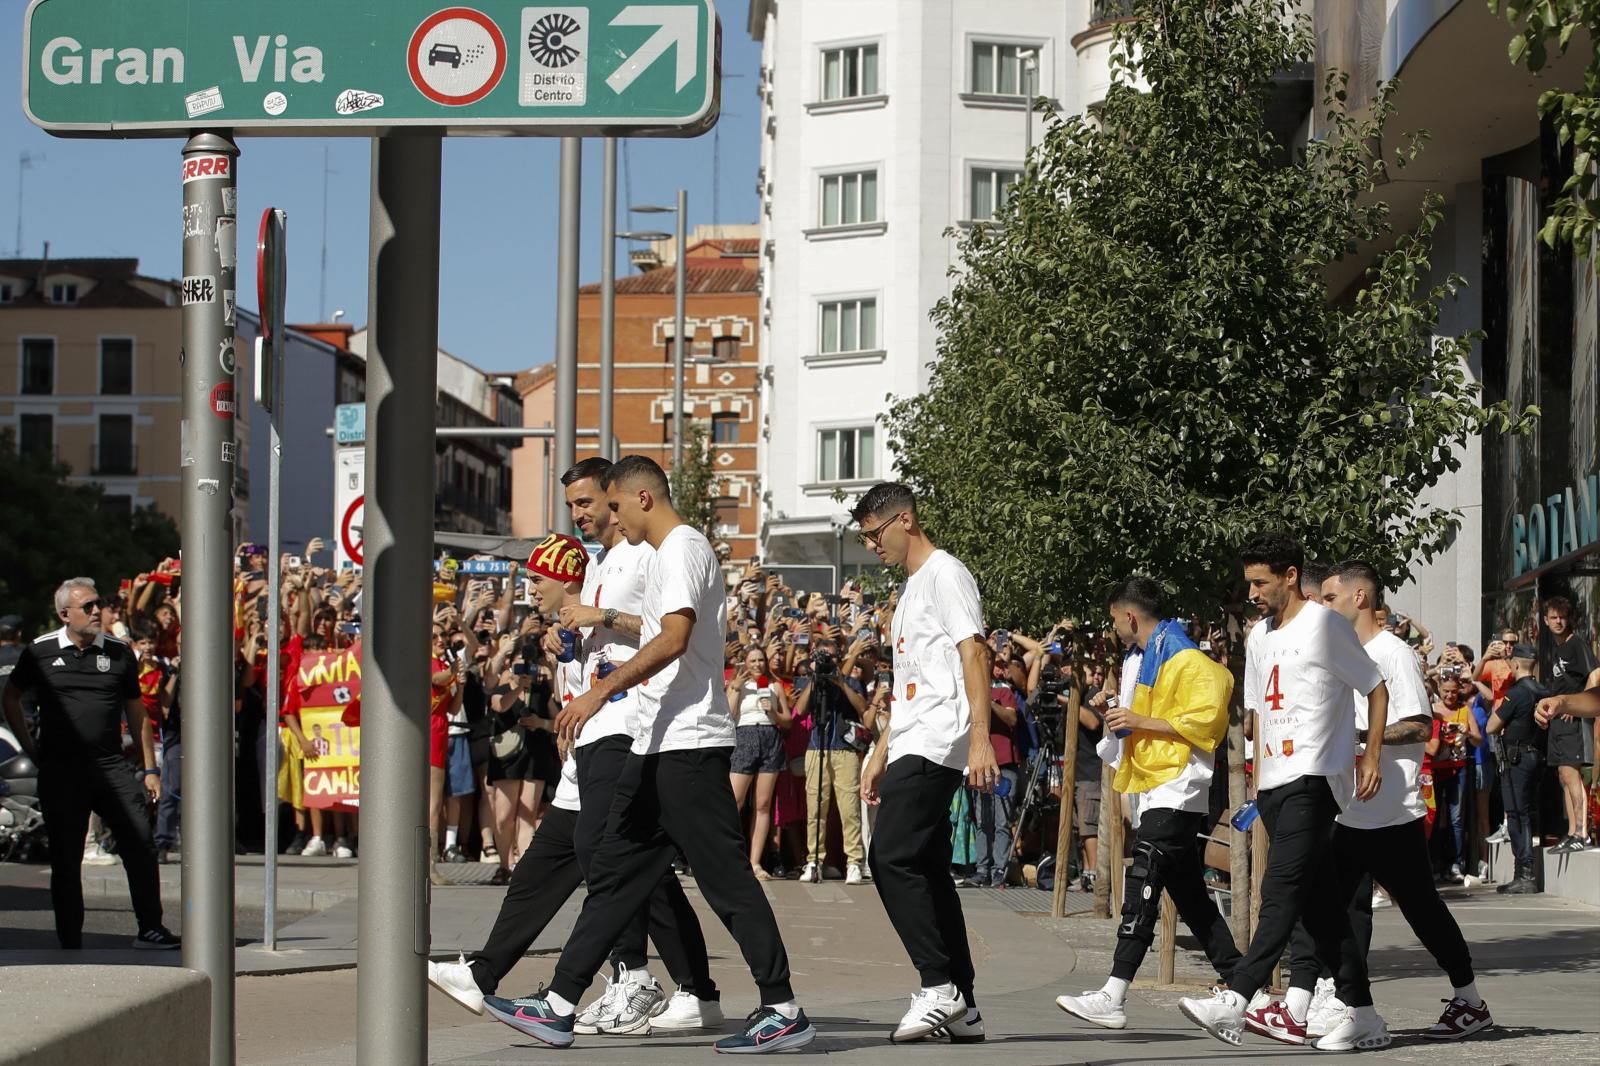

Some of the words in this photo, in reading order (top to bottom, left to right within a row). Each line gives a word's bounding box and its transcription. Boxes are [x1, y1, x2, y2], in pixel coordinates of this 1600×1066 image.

[41, 36, 185, 85] Gran
[233, 34, 325, 83] Via
[535, 90, 572, 101] Centro
[1512, 470, 1600, 577] BOTAN
[1265, 664, 1284, 711] 4
